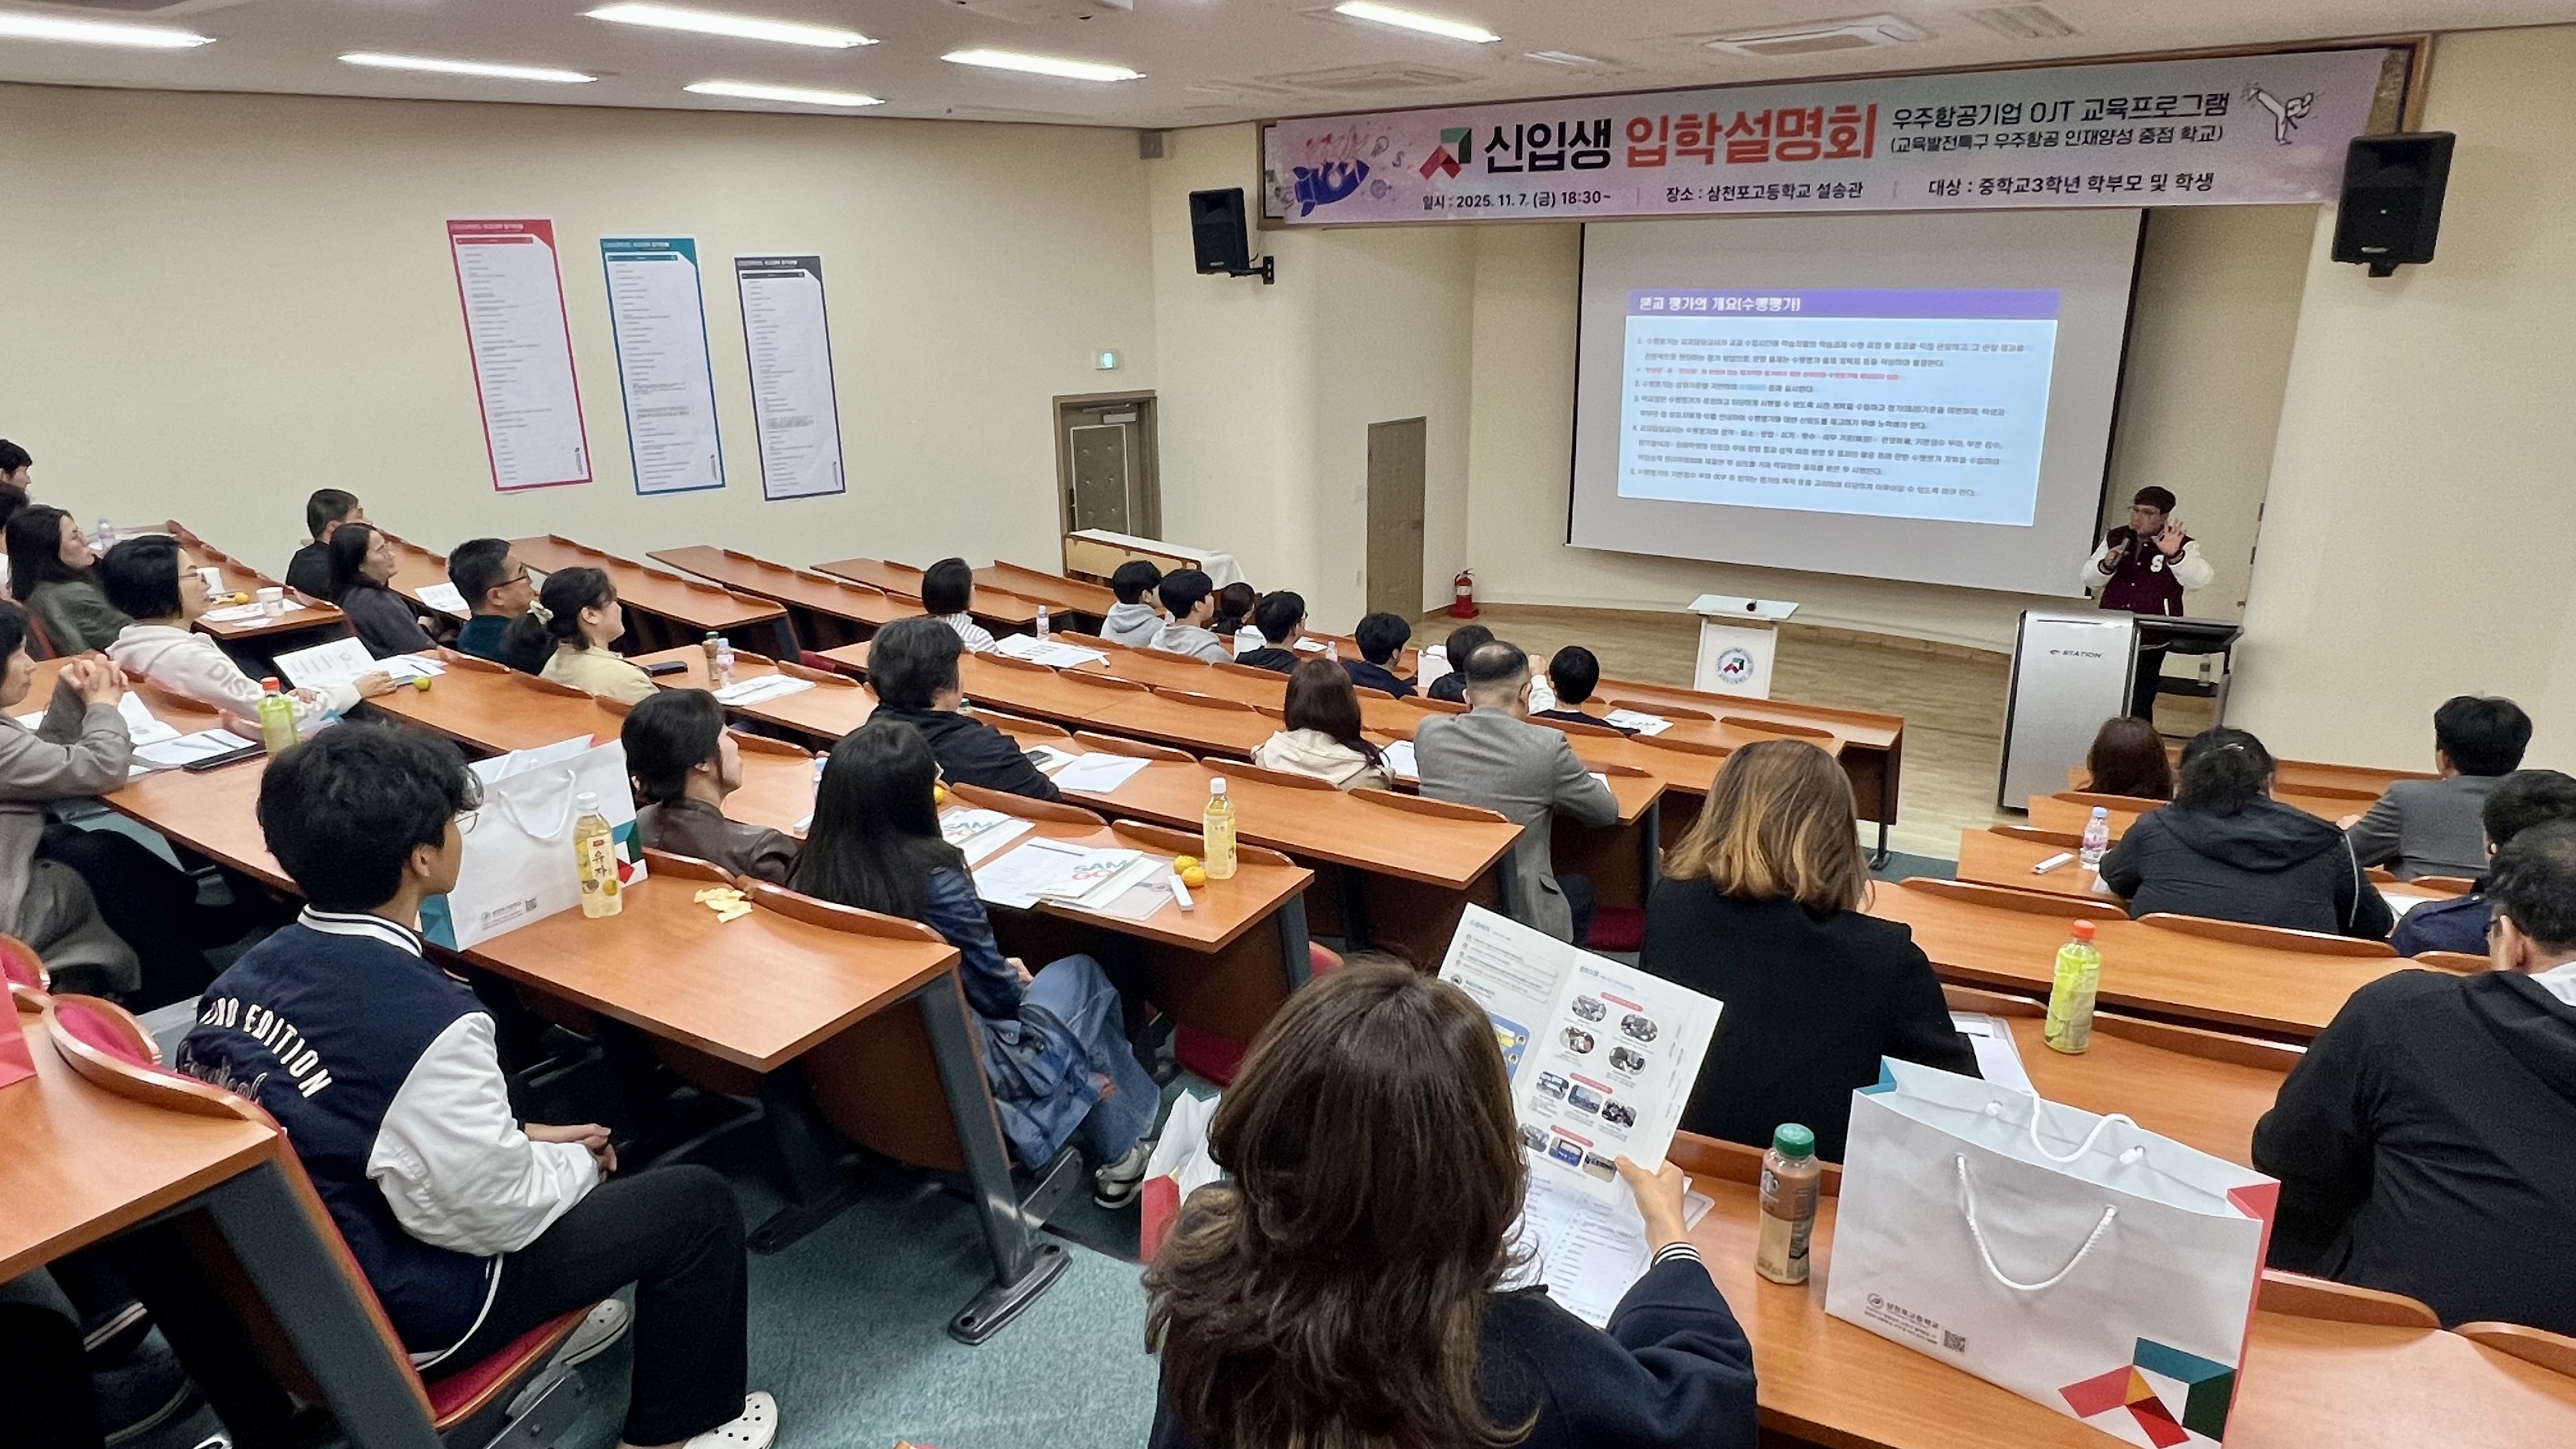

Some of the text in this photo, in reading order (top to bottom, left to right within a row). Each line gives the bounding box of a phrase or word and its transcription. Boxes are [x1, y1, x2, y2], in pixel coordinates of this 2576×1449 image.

[1892, 91, 2230, 130] 우주항공기업 OJT 교육프로그램
[1484, 103, 1878, 173] 신입생 입학설명회
[1890, 125, 2223, 153] (교육발전특구 우주항공 인재양성 중점 학교)
[1666, 187, 1694, 202] 장소
[1707, 183, 1811, 202] 삼천포고등학교
[1816, 181, 1864, 200] 설송관
[1928, 179, 1961, 197] 대상
[1979, 175, 2080, 195] 중학교3학년
[2087, 172, 2143, 192] 학부모
[2150, 173, 2168, 192] 및
[2175, 171, 2214, 192] 학생
[1422, 195, 1445, 210] 일시
[1457, 194, 1495, 208] 2025.
[1533, 192, 1556, 208] (금)
[243, 1003, 333, 1099] EDITION
